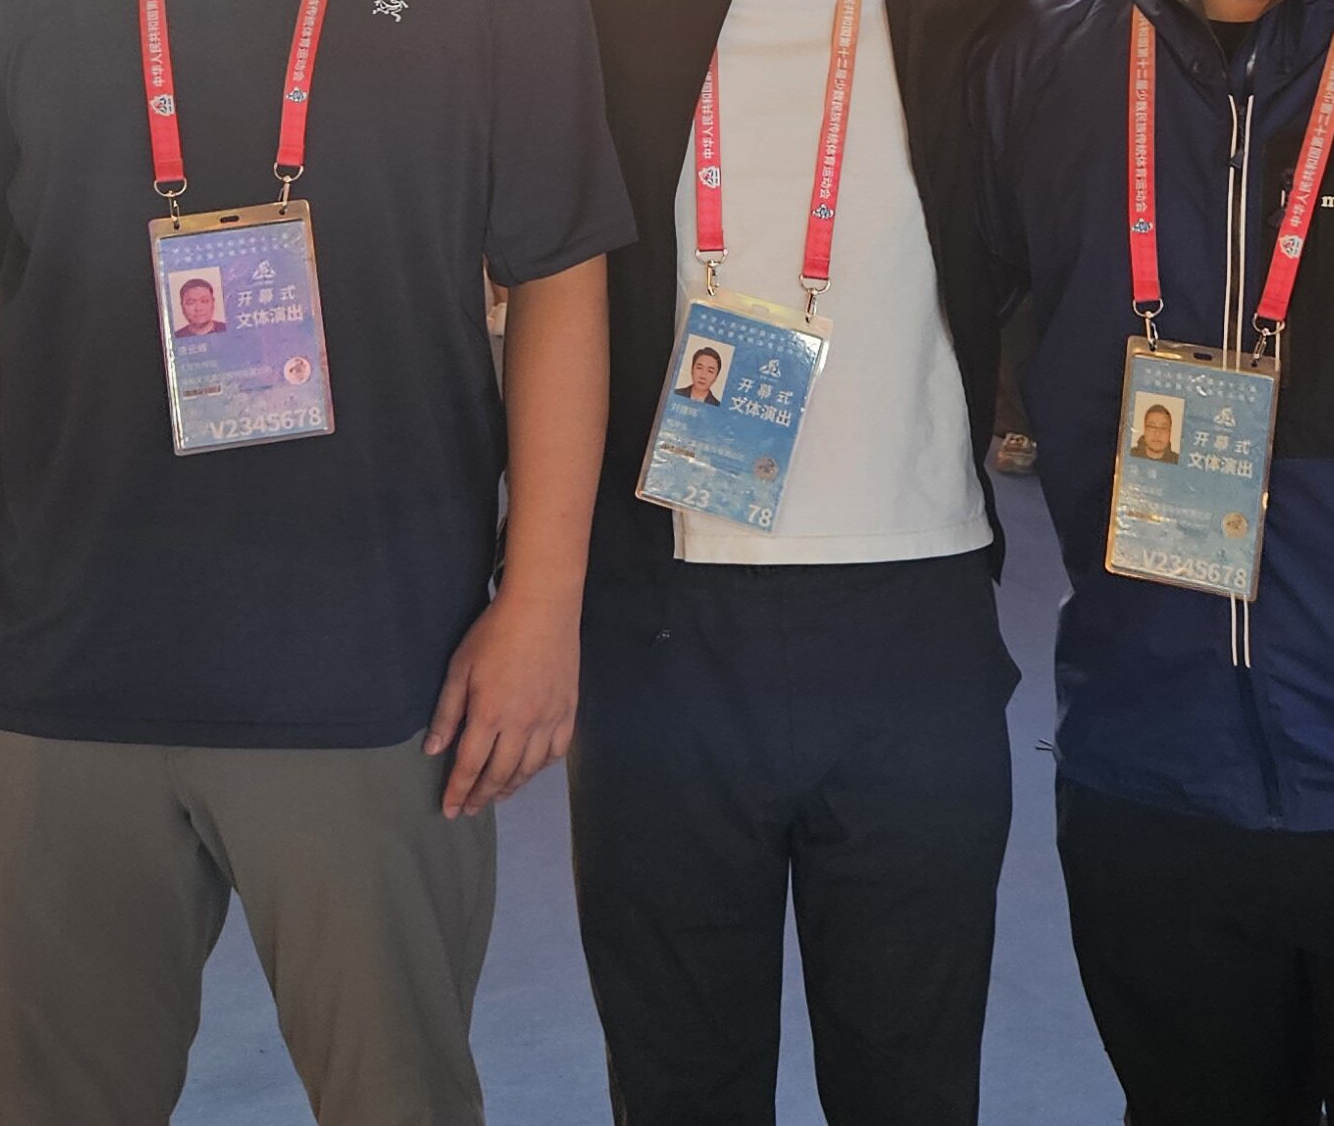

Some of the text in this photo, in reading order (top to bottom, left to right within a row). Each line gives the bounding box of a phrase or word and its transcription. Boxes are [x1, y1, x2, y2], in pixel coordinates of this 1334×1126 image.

[237, 285, 296, 307] 开幕式
[235, 306, 304, 330] 文体演出
[737, 378, 794, 406] 开幕式
[209, 406, 323, 440] V2345678
[728, 396, 793, 428] 文体演出
[1193, 431, 1252, 455] 开幕式
[1187, 451, 1253, 479] 文体演出
[682, 485, 773, 527] 23 78
[1142, 549, 1248, 589] V2345678
